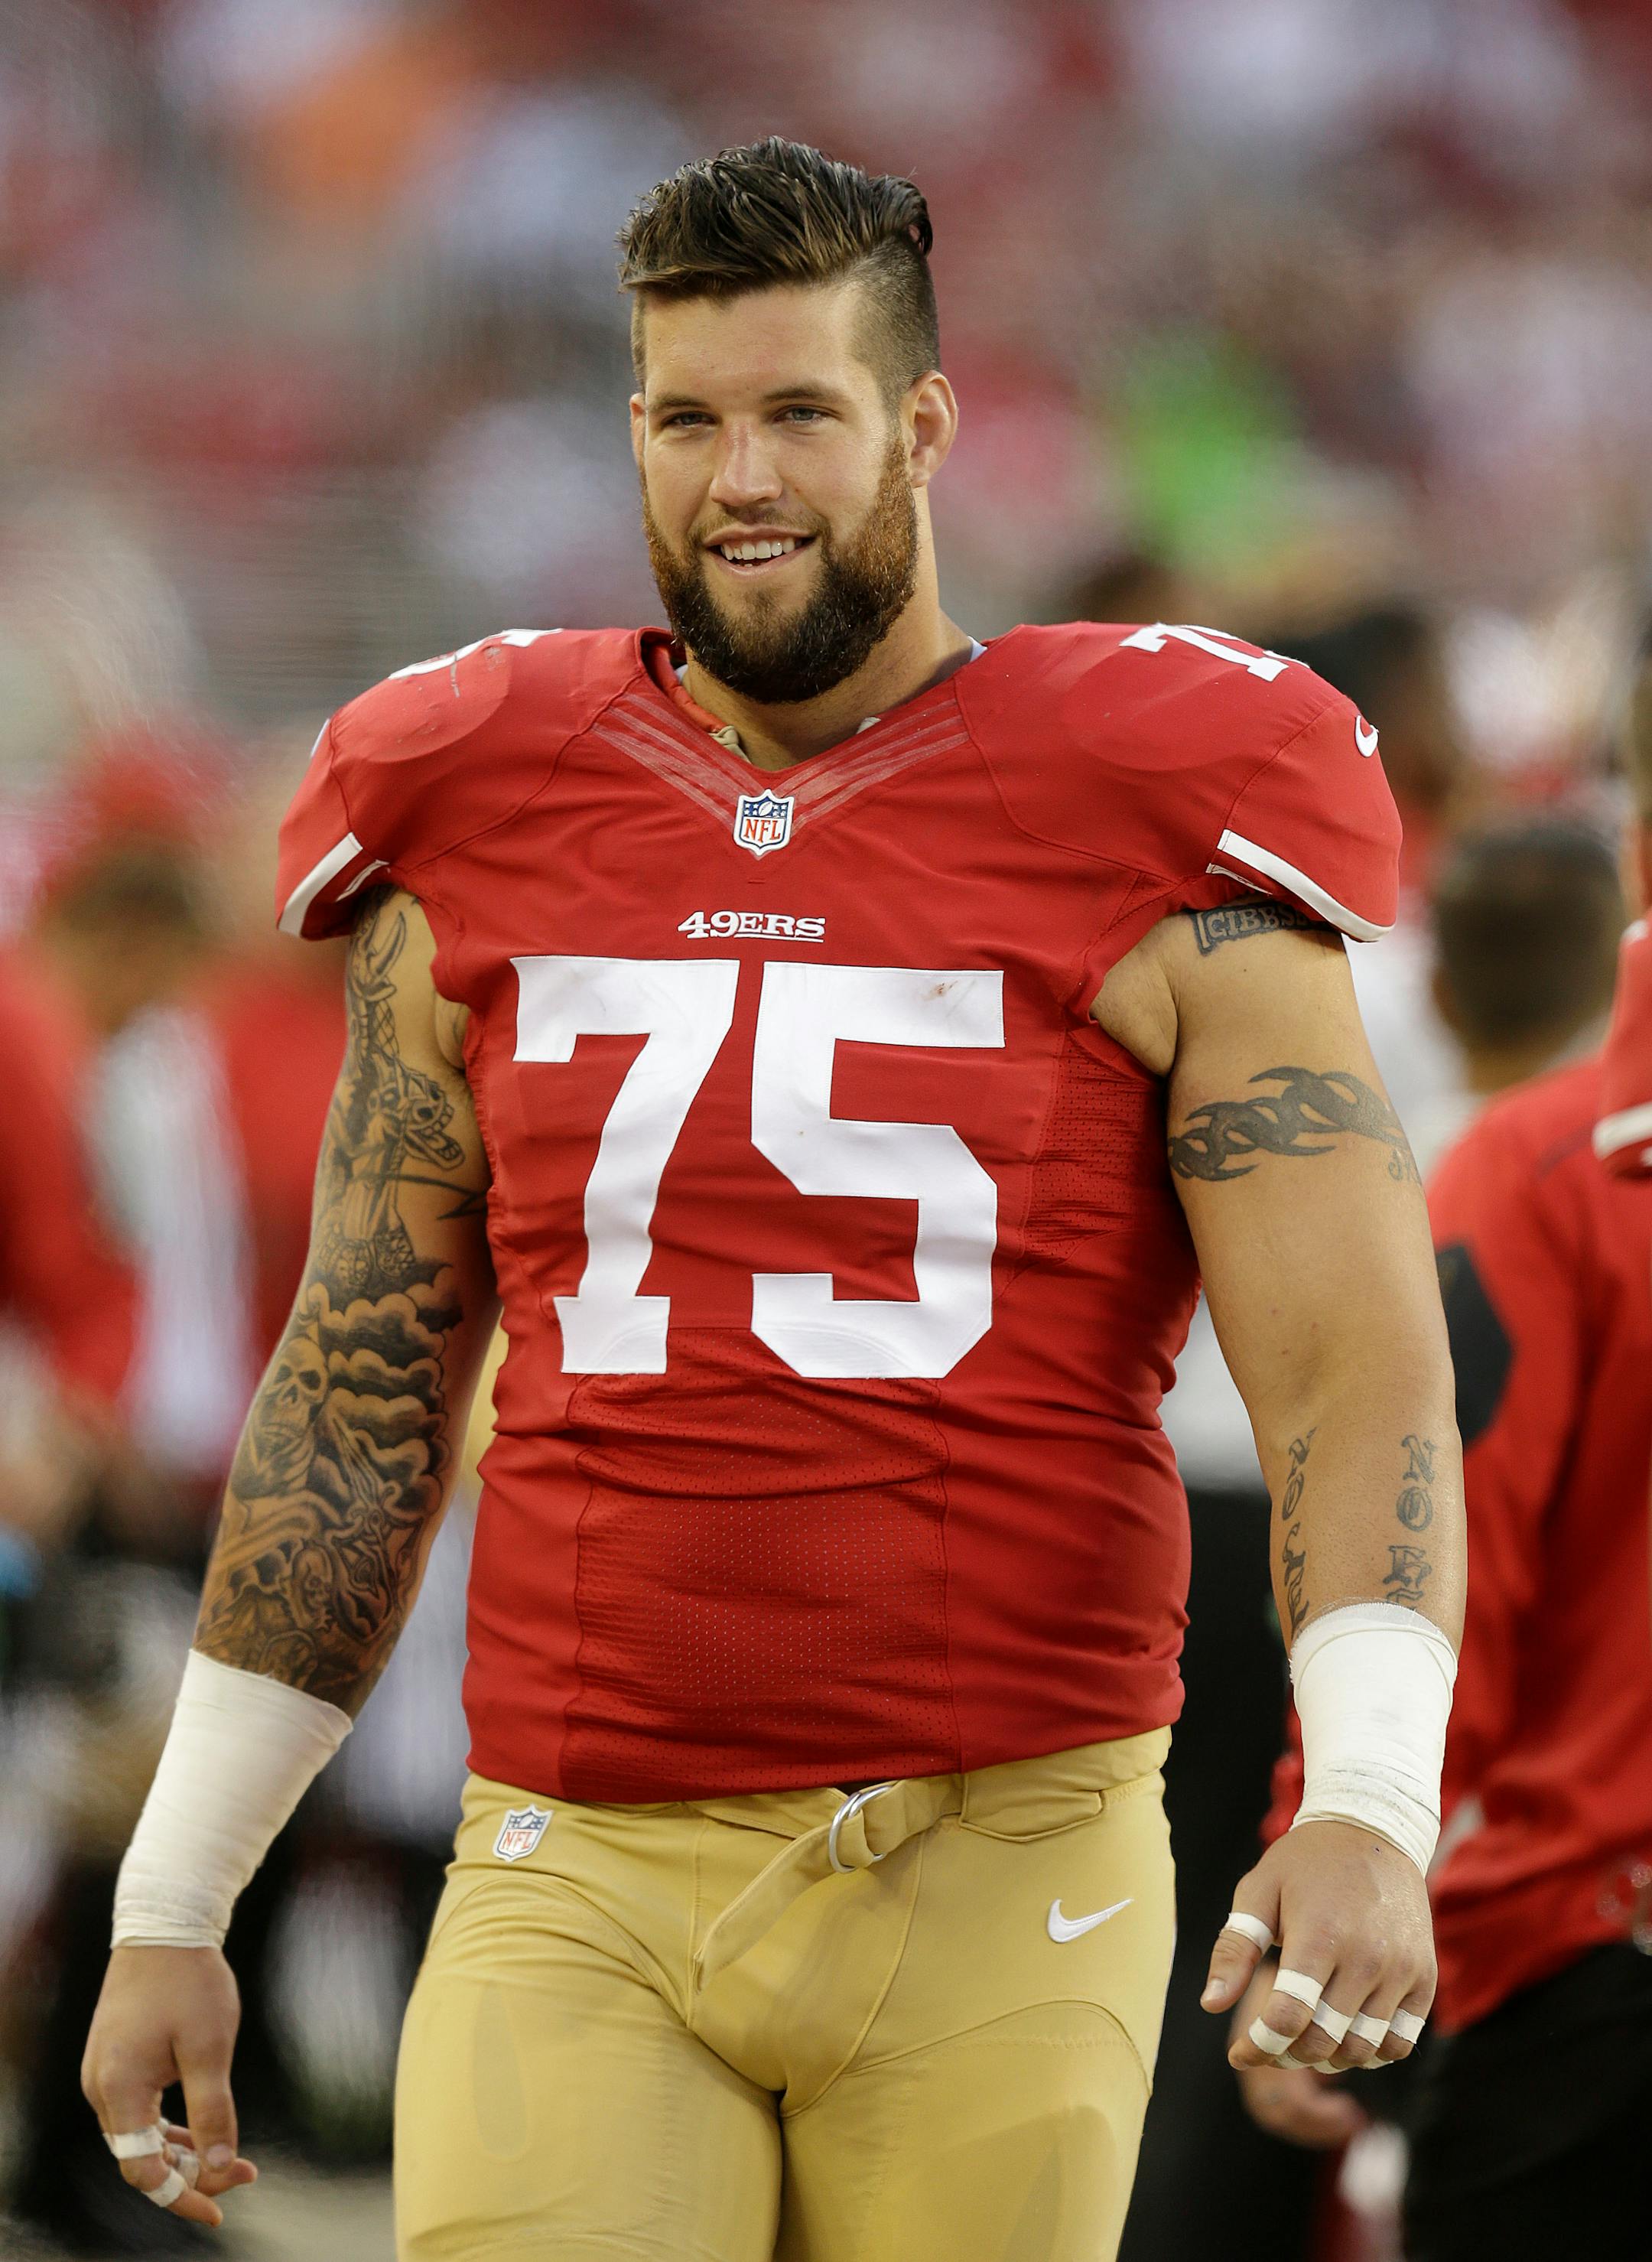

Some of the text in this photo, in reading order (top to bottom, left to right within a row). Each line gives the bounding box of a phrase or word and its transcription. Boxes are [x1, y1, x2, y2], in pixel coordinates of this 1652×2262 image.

[1119, 622, 1310, 682] 7
[743, 819, 781, 843] NFL
[677, 910, 826, 942] 49ERS
[509, 954, 1006, 1379] 75
[500, 1831, 534, 1853] NFL
